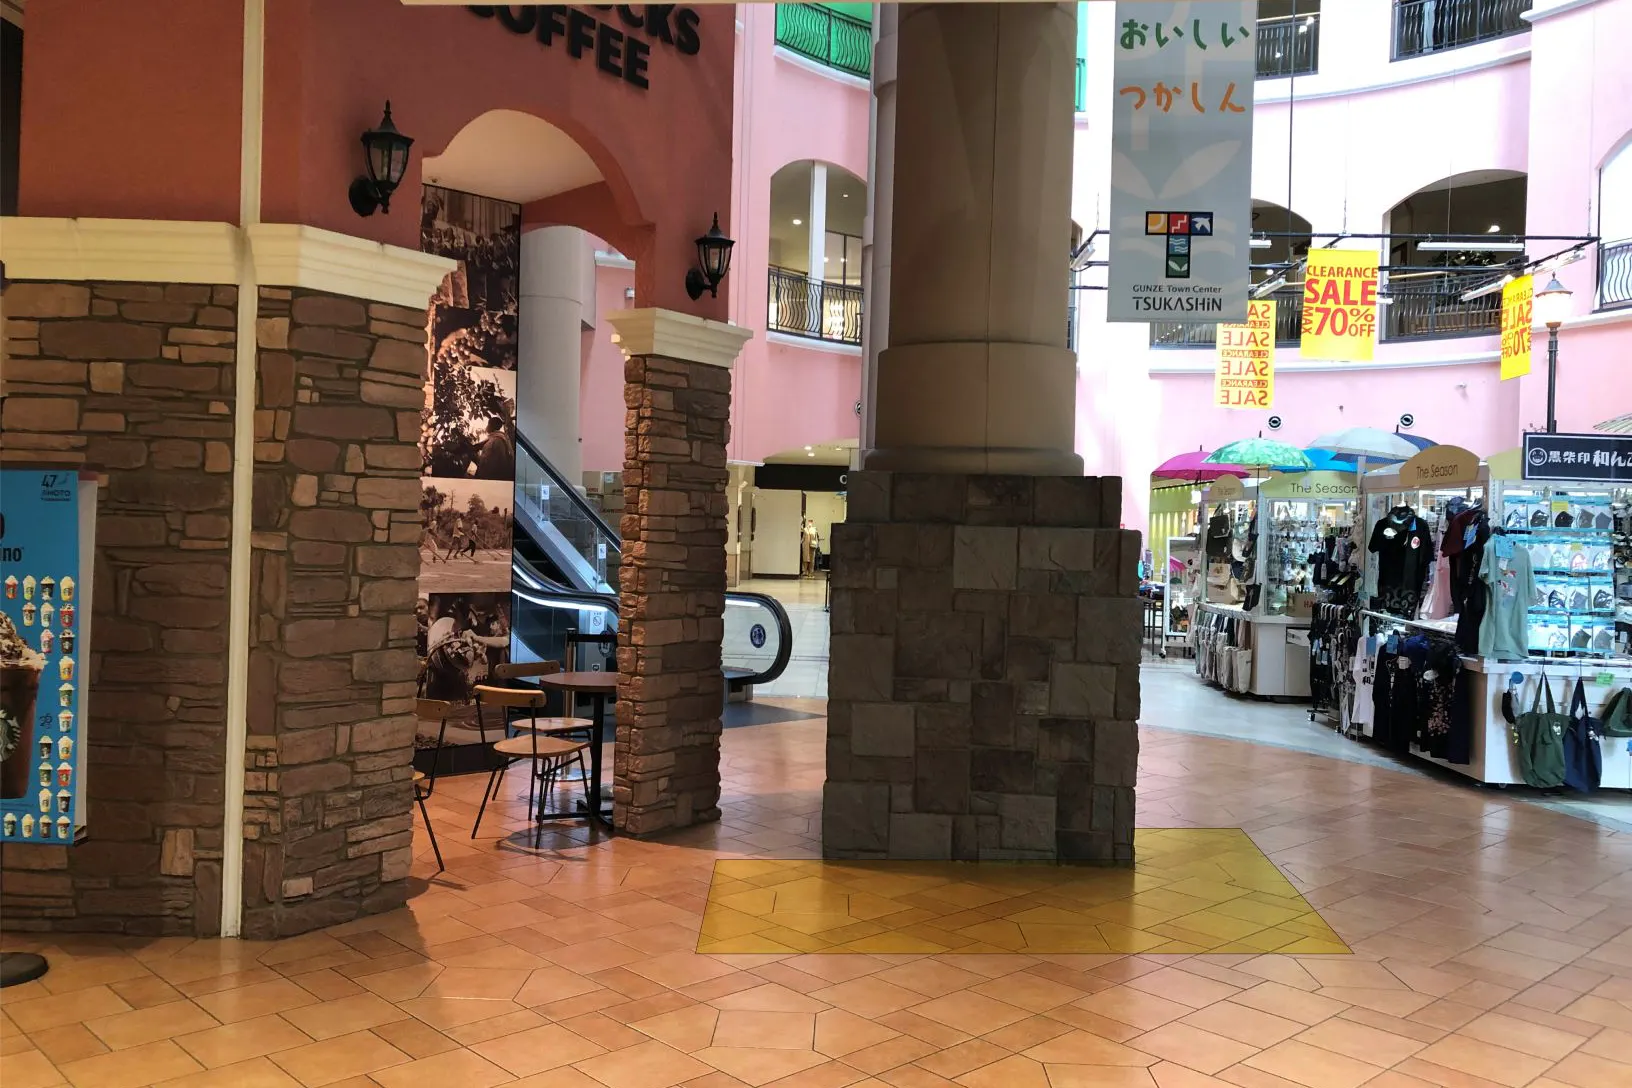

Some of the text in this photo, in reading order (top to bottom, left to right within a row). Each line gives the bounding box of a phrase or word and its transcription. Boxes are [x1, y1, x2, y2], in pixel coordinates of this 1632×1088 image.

[1120, 19, 1250, 50] おいしい
[1120, 82, 1246, 113] つかしん
[1306, 265, 1378, 278] CLEARANCE
[1132, 284, 1222, 294] GUNZE Town Center
[1304, 278, 1377, 306] SALE
[1302, 305, 1314, 334] MAX
[1348, 323, 1375, 337] OFF
[1291, 482, 1312, 494] The
